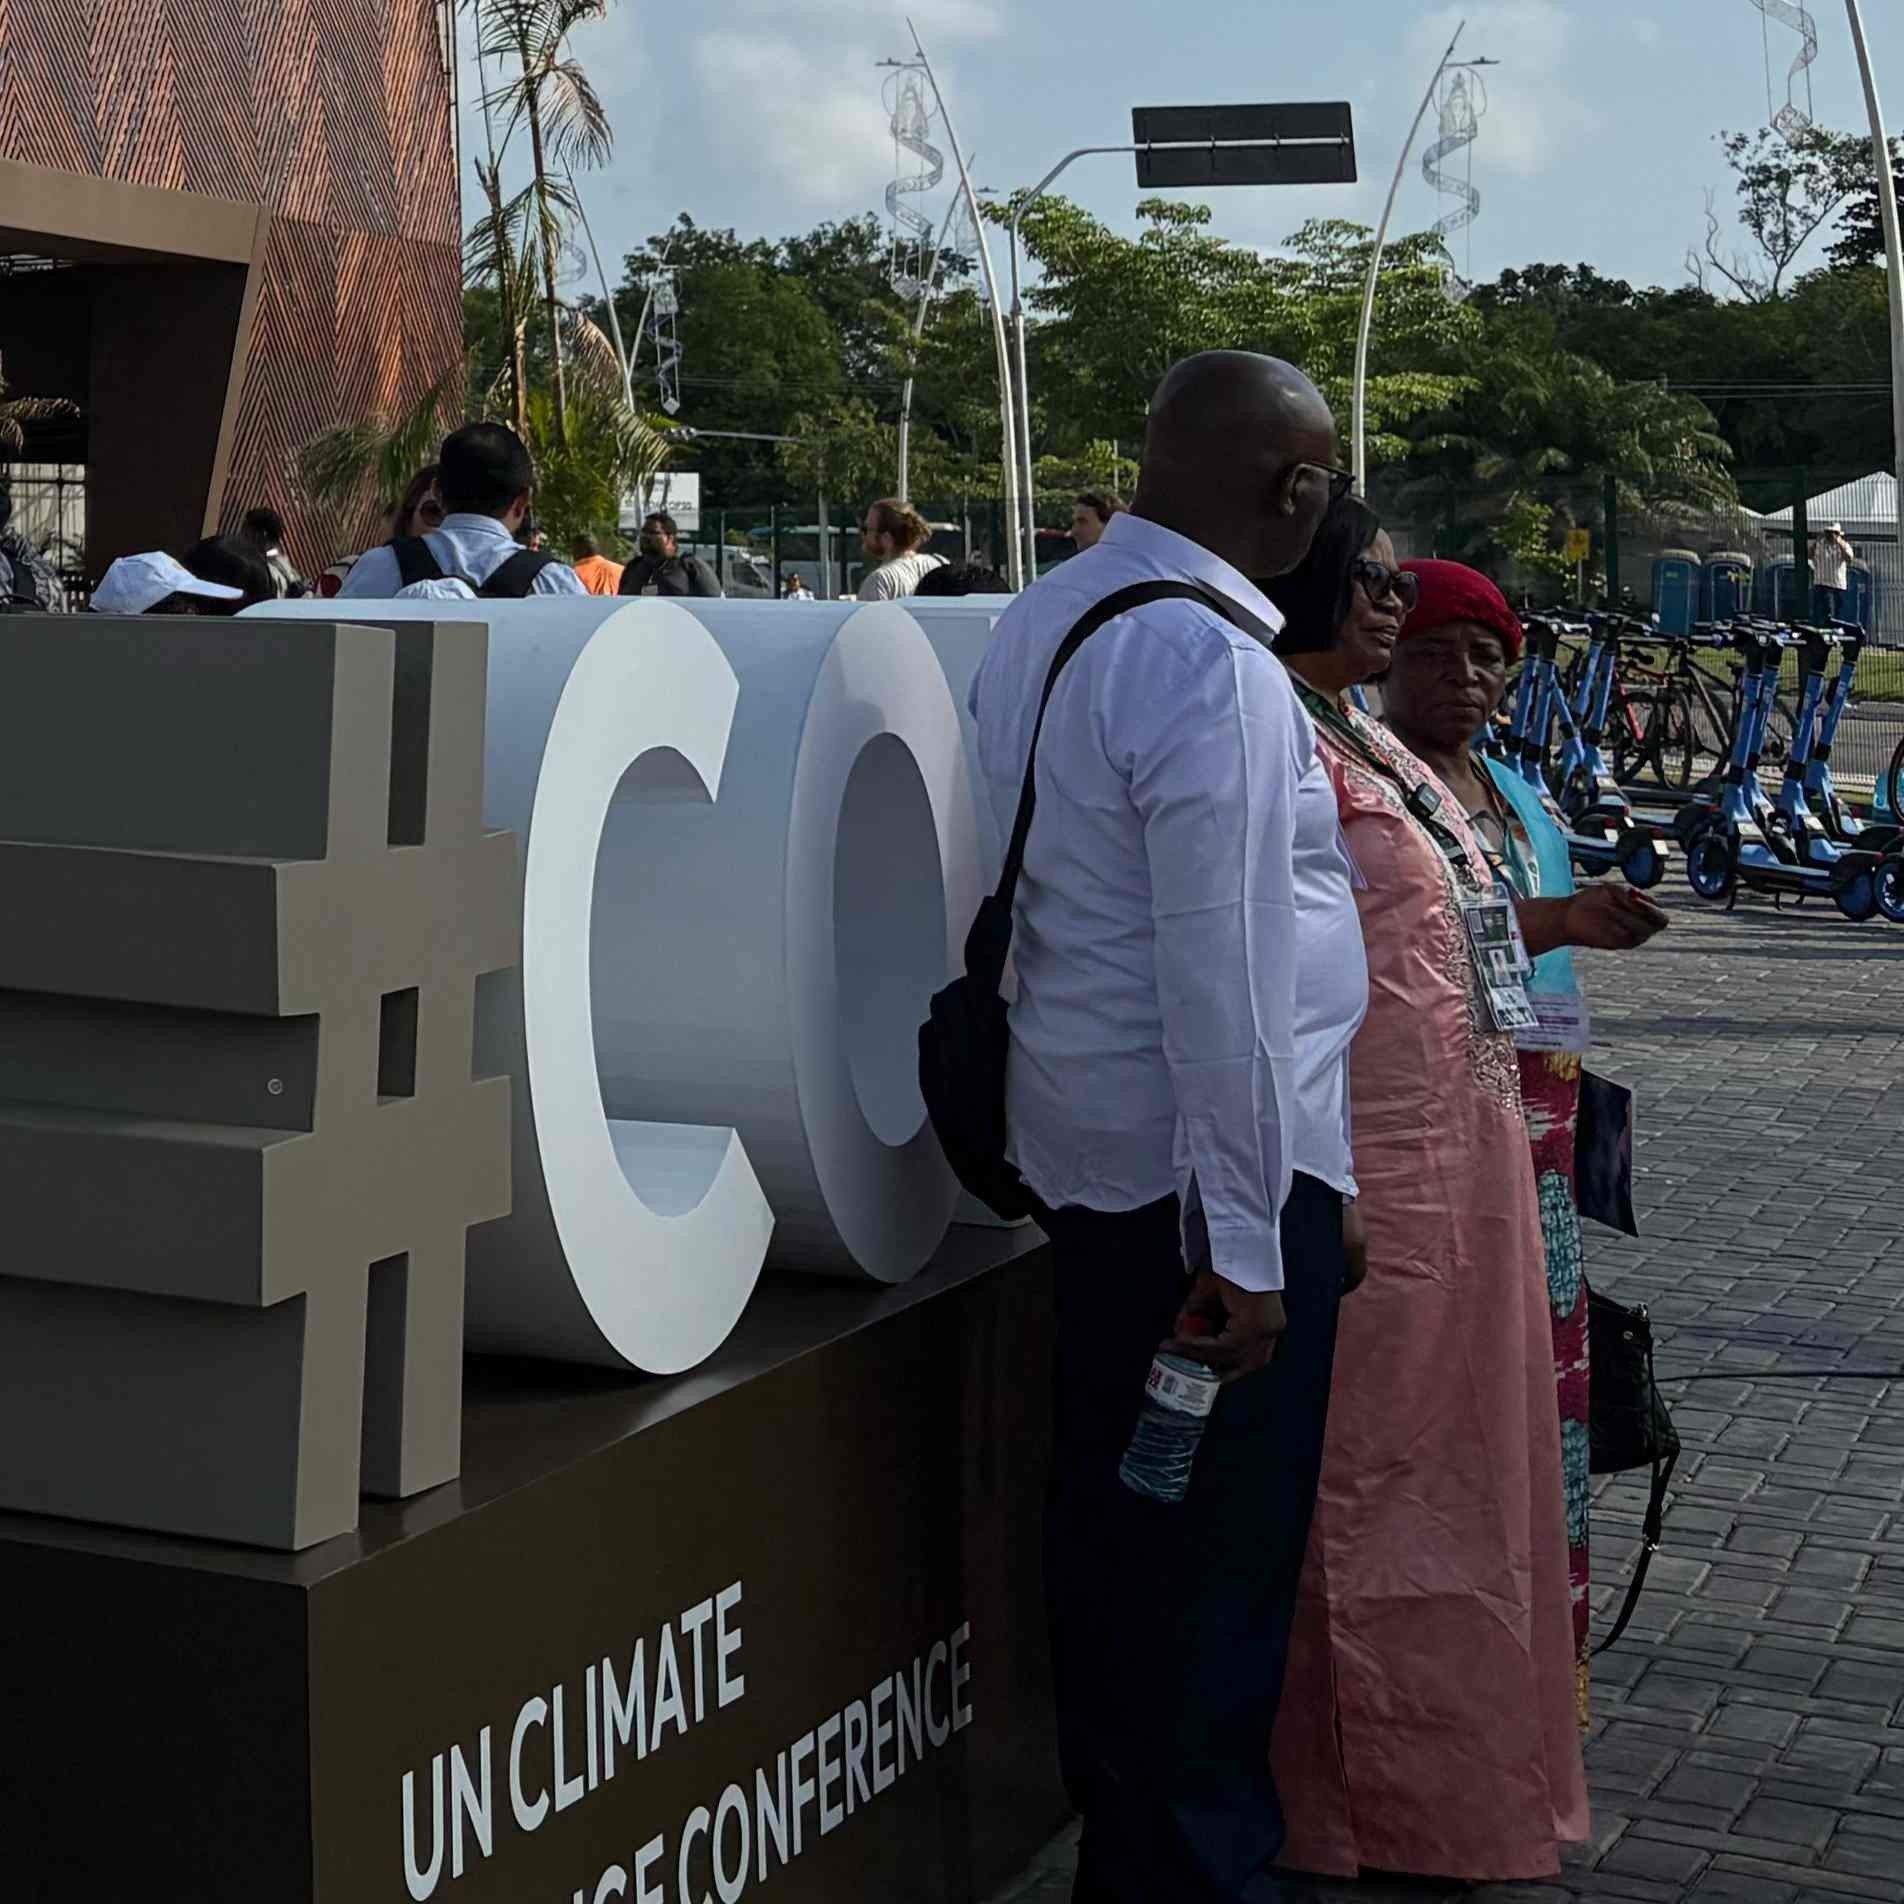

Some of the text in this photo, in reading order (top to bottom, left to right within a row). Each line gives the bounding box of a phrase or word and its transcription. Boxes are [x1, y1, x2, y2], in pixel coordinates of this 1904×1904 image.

[401, 1580, 746, 1902] UN CLIMATE
[678, 1620, 974, 1904] CONFERENCE
